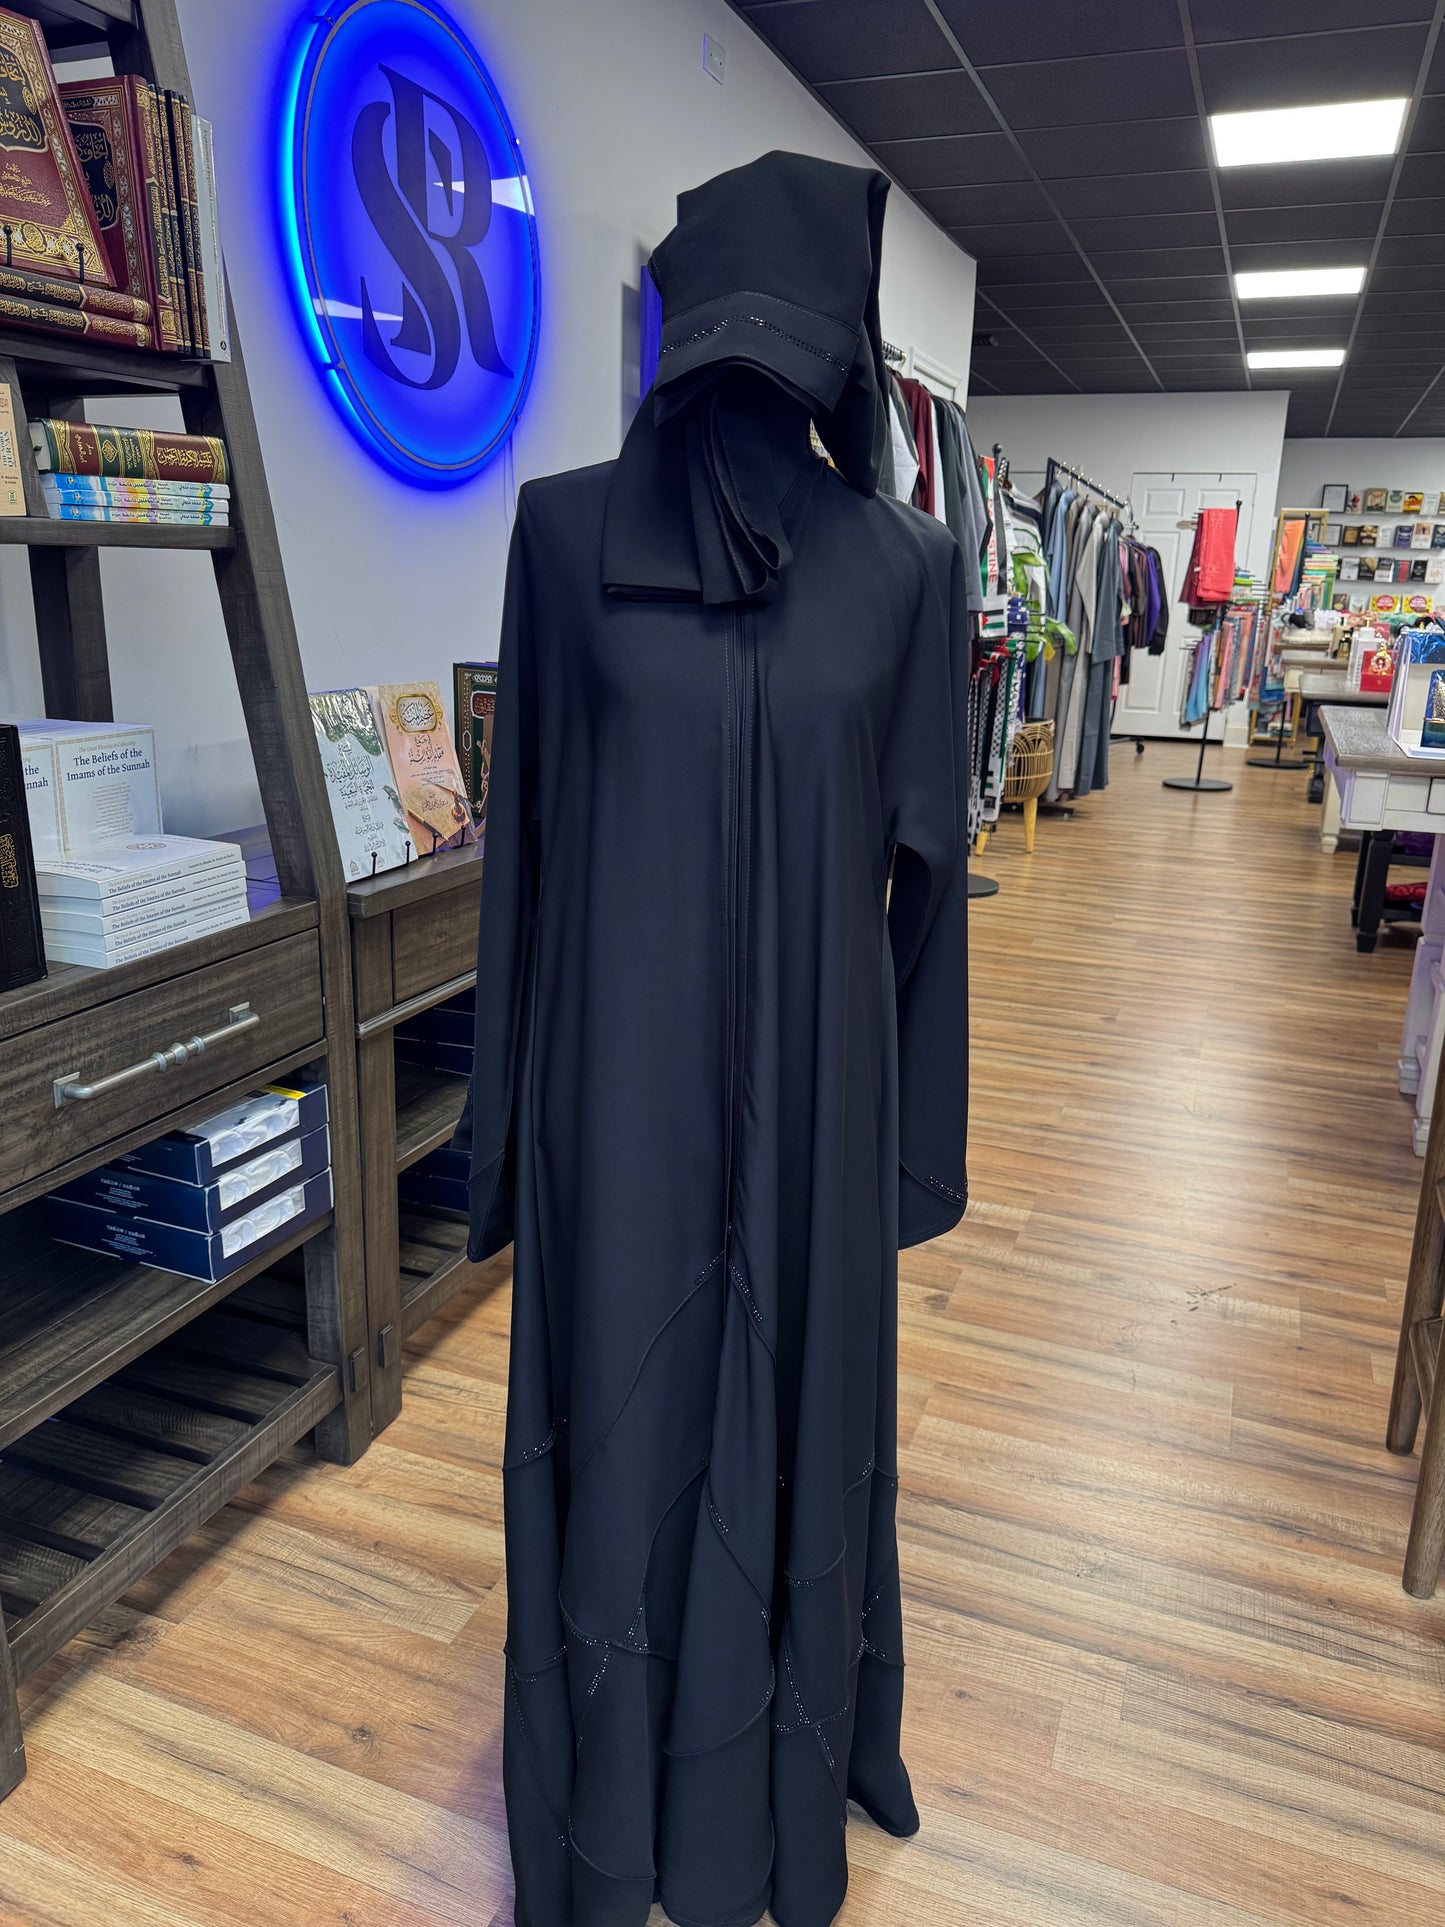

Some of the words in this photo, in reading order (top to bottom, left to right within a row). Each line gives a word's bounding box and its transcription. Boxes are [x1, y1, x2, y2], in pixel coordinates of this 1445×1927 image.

[73, 757, 90, 767] The
[92, 750, 119, 764] Beliefs
[120, 748, 129, 759] of
[129, 747, 143, 758] the
[24, 765, 40, 776] the
[66, 769, 96, 782] Imams
[97, 766, 107, 777] of
[107, 764, 120, 775] the
[121, 759, 151, 773] Sunnah
[26, 777, 49, 790] nnah
